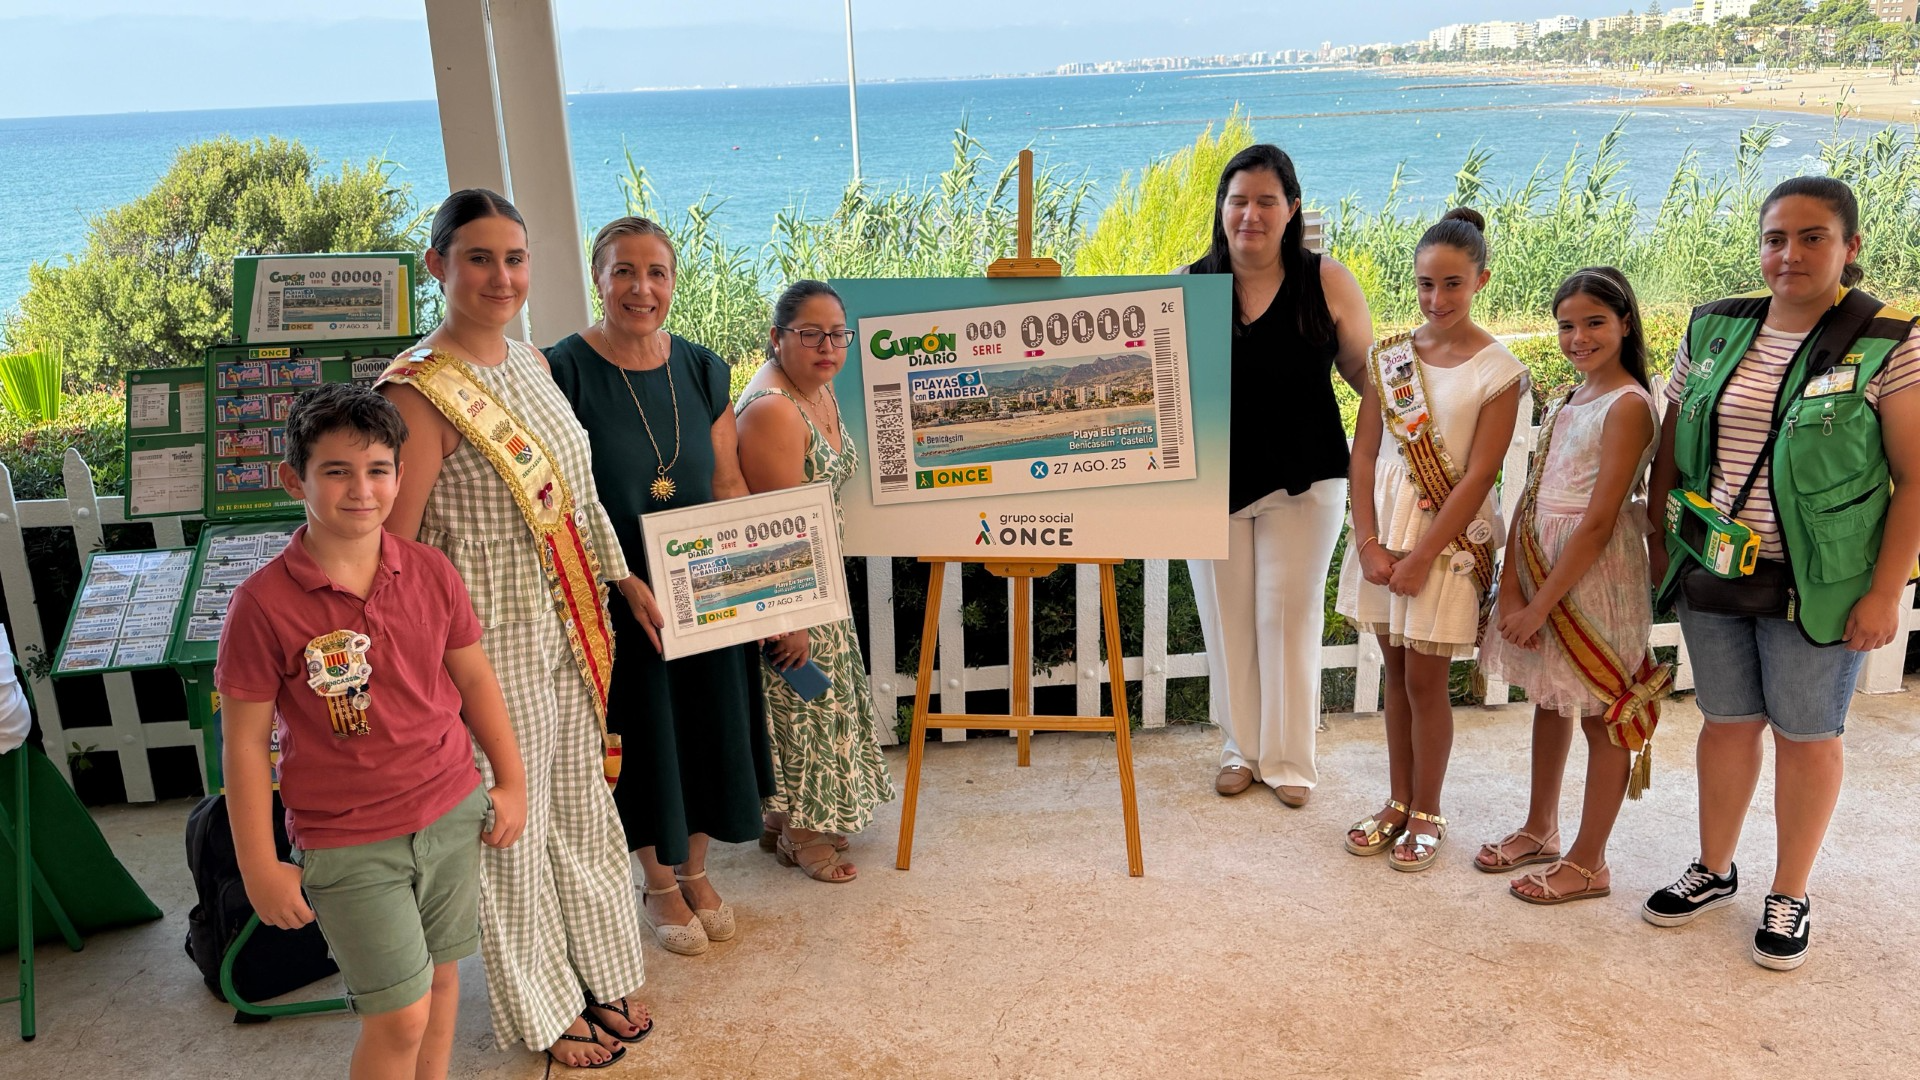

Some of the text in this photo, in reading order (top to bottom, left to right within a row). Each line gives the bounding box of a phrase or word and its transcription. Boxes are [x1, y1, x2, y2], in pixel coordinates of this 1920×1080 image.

[331, 270, 382, 283] 00000
[1161, 301, 1175, 314] 2€
[966, 320, 1006, 341] 000
[1021, 305, 1146, 349] 00000
[261, 349, 288, 357] ONCE
[972, 344, 1002, 356] SERIE
[1387, 353, 1407, 367] 2024
[914, 378, 958, 391] PLAYAS
[928, 385, 986, 400] BANDERA
[467, 398, 487, 418] 2024
[1073, 424, 1153, 440] Playa Els Terrers
[1121, 435, 1154, 446] Castelló
[1053, 462, 1069, 475] 27
[1073, 459, 1109, 473] AGO.
[1111, 457, 1127, 470] 25
[937, 468, 988, 485] ONCE
[1000, 513, 1073, 525] grupo social
[717, 528, 738, 542] 000
[745, 515, 806, 543] 00000
[999, 528, 1073, 546] ONCE
[721, 541, 736, 550] SERIE
[1709, 535, 1718, 559] ONCE
[691, 562, 715, 572] PLAYAS
[700, 565, 730, 576] BANDERA
[767, 600, 775, 608] 27
[708, 609, 735, 622] ONCE
